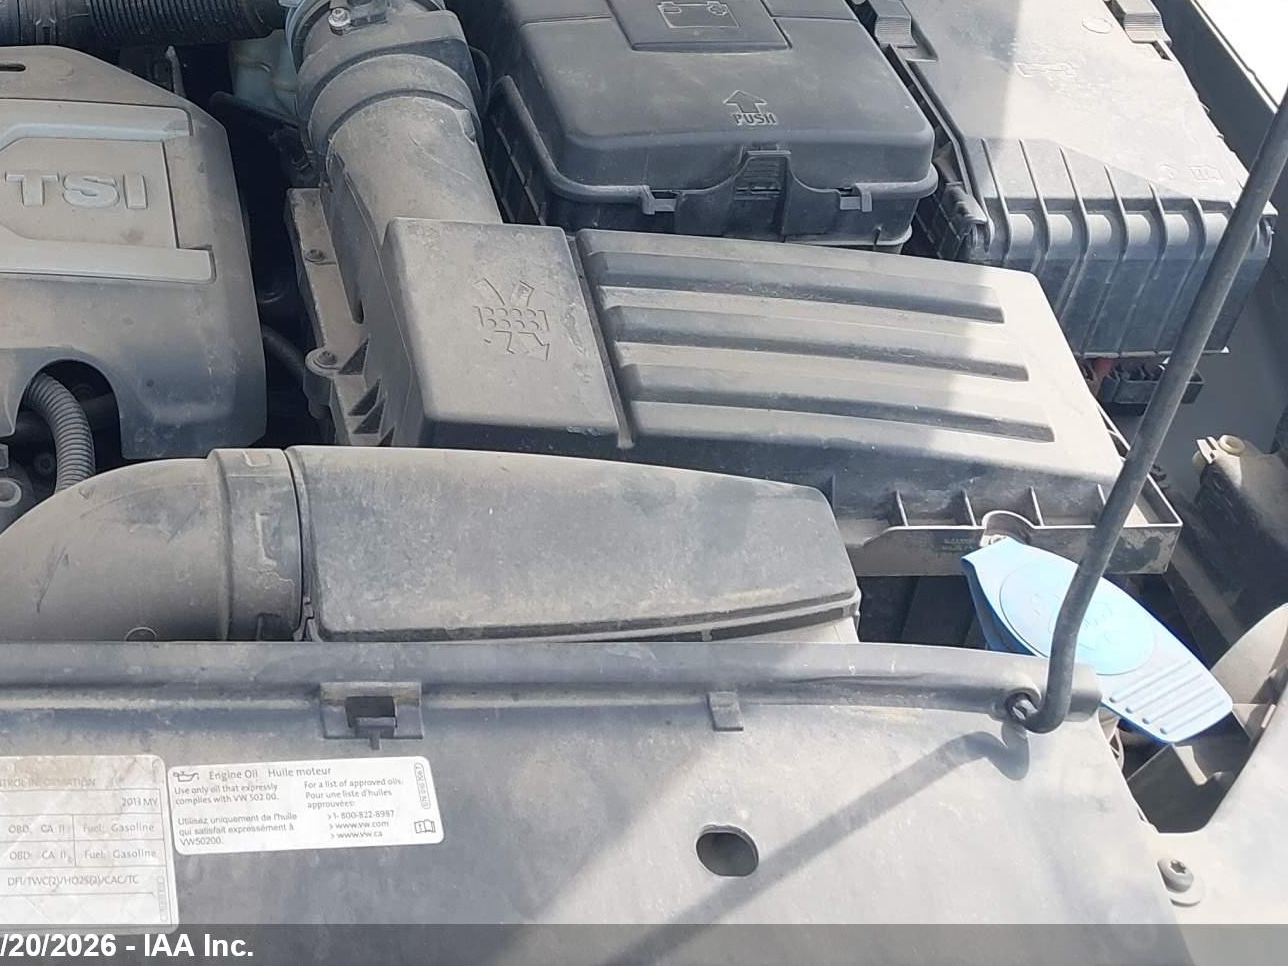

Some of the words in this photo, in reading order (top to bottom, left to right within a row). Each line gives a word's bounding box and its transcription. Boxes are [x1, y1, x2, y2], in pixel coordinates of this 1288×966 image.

[732, 112, 778, 126] PUSH
[6, 169, 149, 210] TSI
[209, 771, 242, 782] Engine
[244, 769, 258, 779] Oil
[268, 768, 295, 778] Huile
[296, 767, 332, 777] moteur
[174, 786, 190, 795] Use
[192, 785, 208, 795] only
[210, 784, 220, 793] oil
[222, 784, 238, 793] that
[240, 782, 278, 794] expressly
[304, 781, 317, 789] For
[325, 779, 337, 787] list
[339, 778, 348, 787] of
[349, 778, 386, 790] approved
[176, 795, 212, 806] complies
[213, 794, 231, 803] with
[233, 794, 248, 802] VW
[306, 791, 324, 799] Pour
[343, 789, 359, 797] liste
[143, 796, 159, 807] MY
[111, 821, 155, 833] Gasoline
[210, 815, 259, 827] uniquement
[336, 820, 390, 829] www.vw.com
[179, 827, 192, 837] qui
[41, 849, 56, 860] CA
[112, 847, 158, 859] Gasoline
